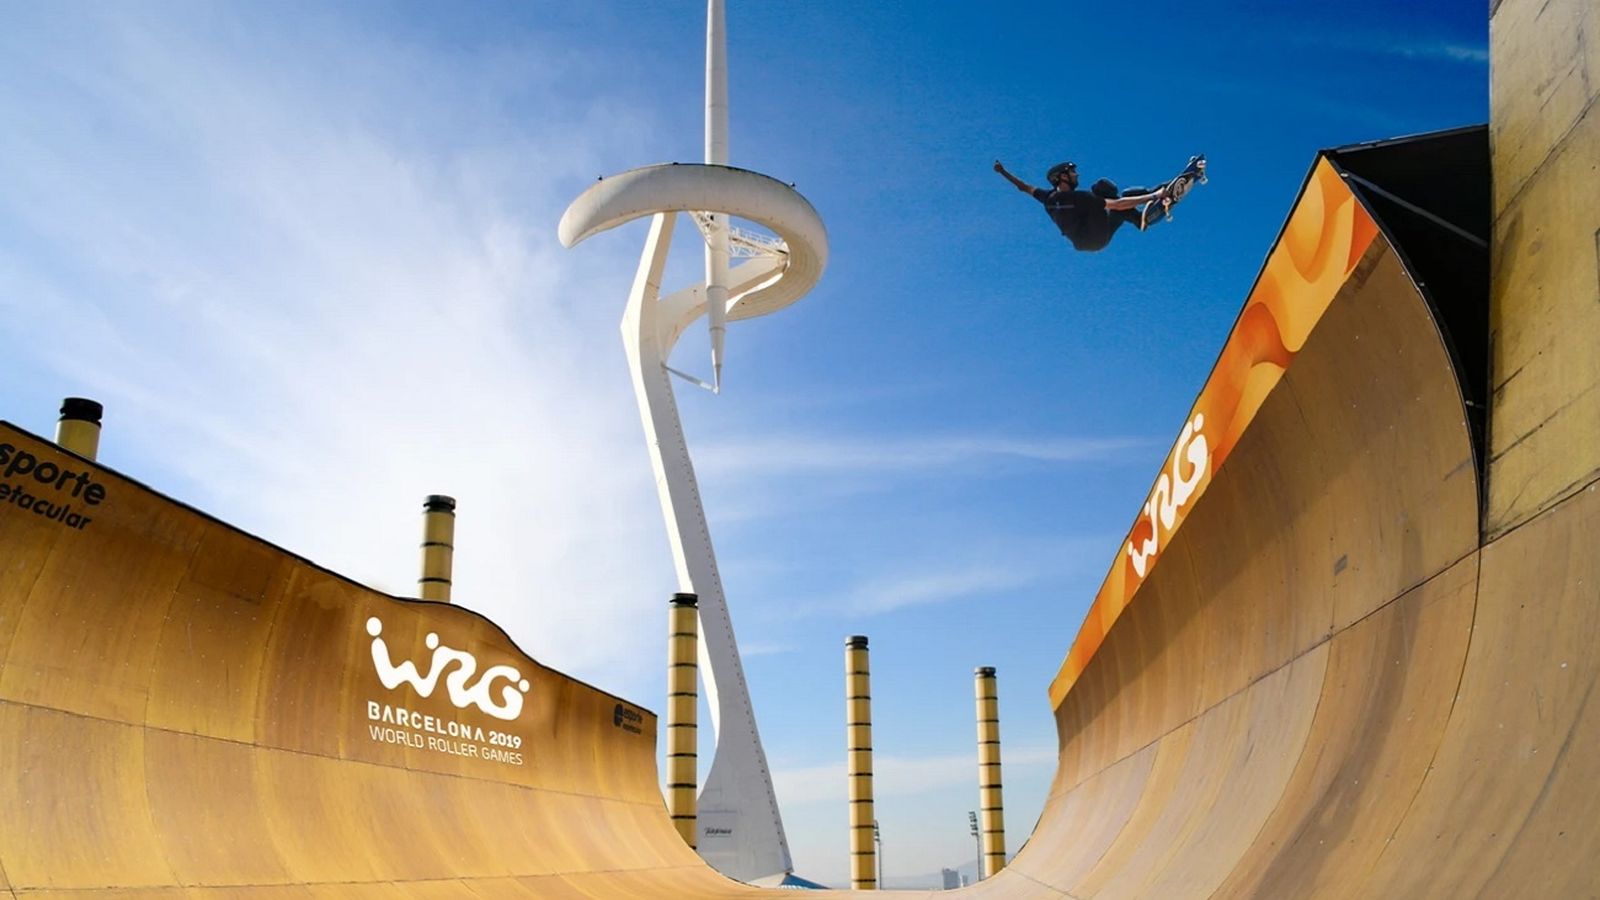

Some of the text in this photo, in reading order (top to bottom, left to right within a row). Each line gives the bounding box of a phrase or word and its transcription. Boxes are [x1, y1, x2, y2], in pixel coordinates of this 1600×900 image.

[368, 701, 522, 749] BARCELONA 2019
[369, 725, 523, 765] WORLD ROLLER GAMES
